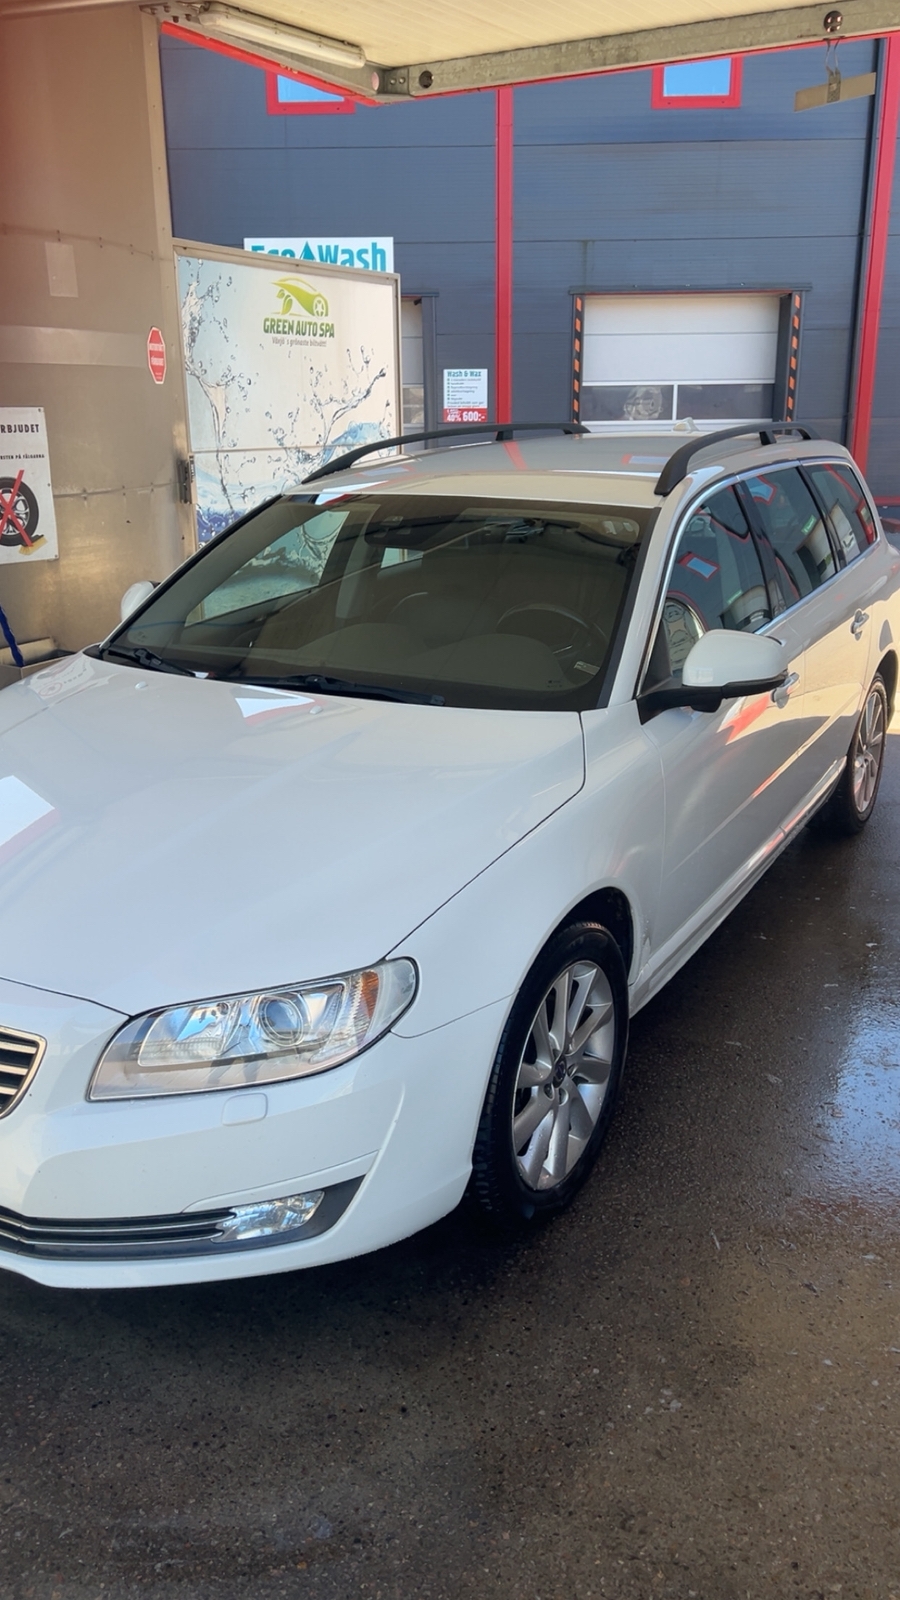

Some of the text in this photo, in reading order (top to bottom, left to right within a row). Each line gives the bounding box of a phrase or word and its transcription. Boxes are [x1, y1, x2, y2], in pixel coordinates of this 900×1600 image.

[263, 318, 335, 338] GREEN AUTO SPA
[462, 411, 485, 421] 600:-
[0, 424, 39, 433] RBJUDET
